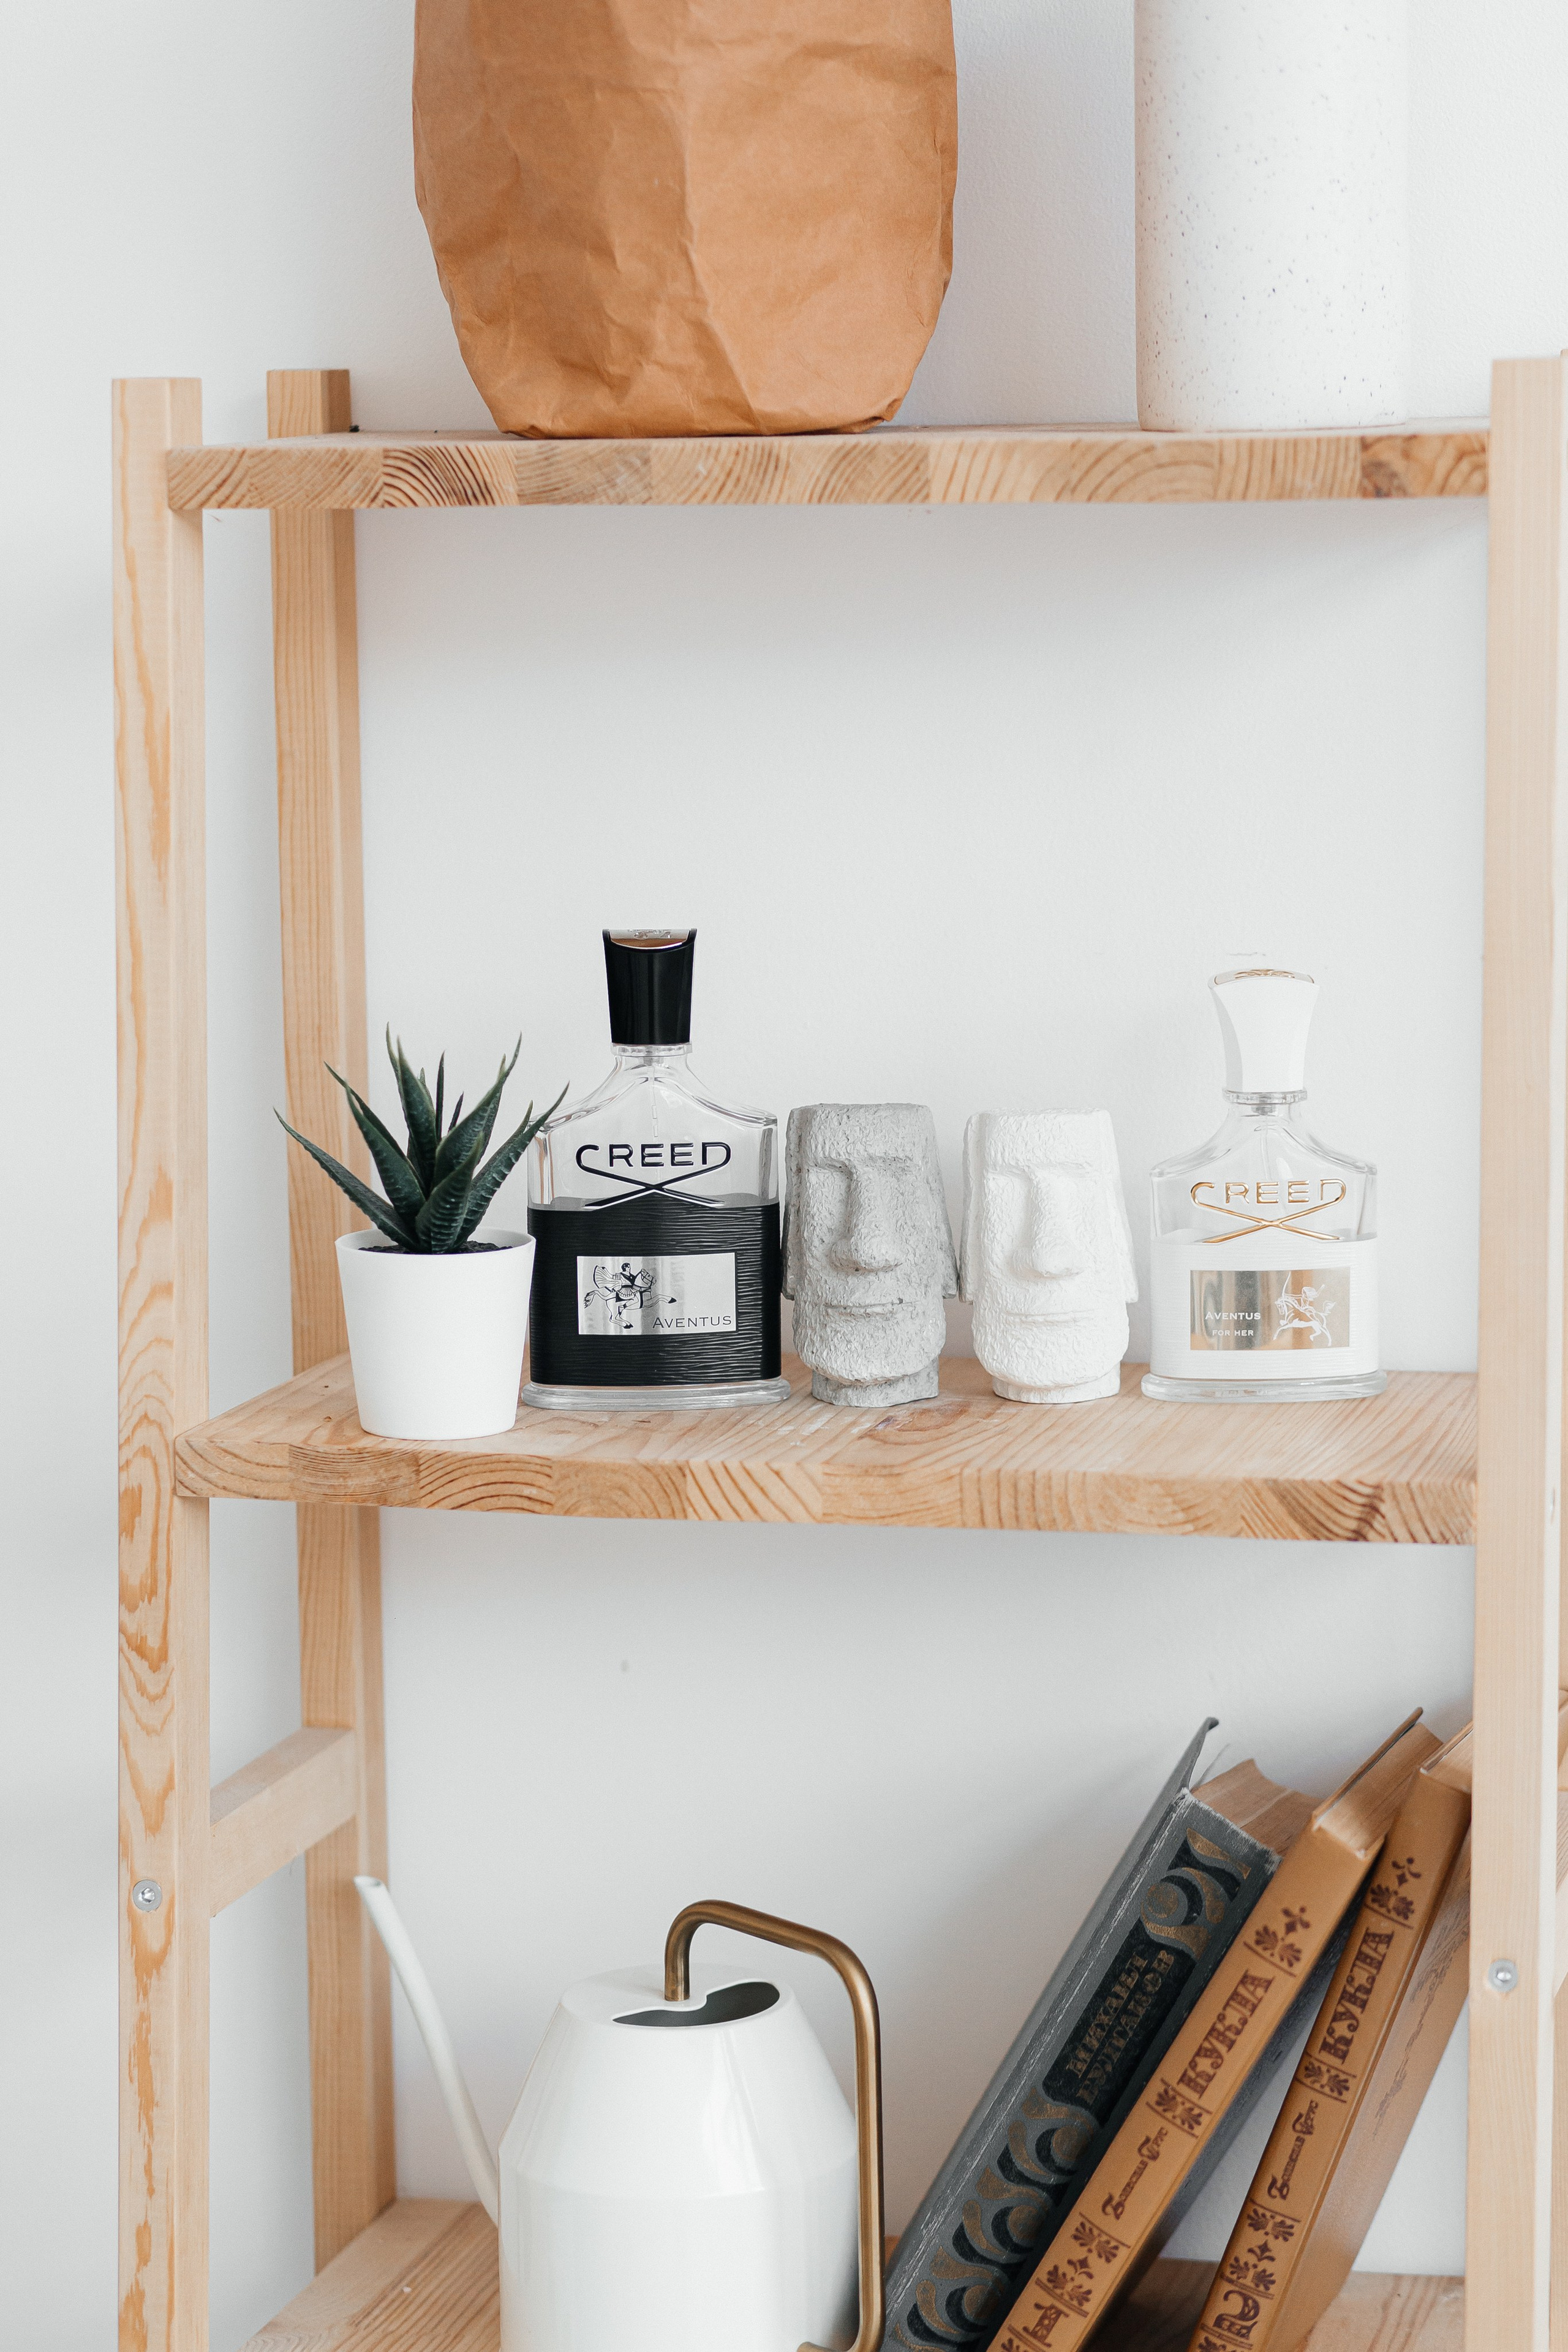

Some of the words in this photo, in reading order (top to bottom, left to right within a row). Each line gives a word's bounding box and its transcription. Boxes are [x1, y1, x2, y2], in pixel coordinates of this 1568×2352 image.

[575, 1141, 732, 1169] CREED
[1190, 1178, 1347, 1205] CREED
[652, 1315, 733, 1329] AVENTUS
[1205, 1311, 1262, 1321] AVENTUS
[1319, 1927, 1395, 2065] КУКЛА
[1177, 1969, 1275, 2100] КУКЛА
[1213, 2290, 1261, 2340] 2
